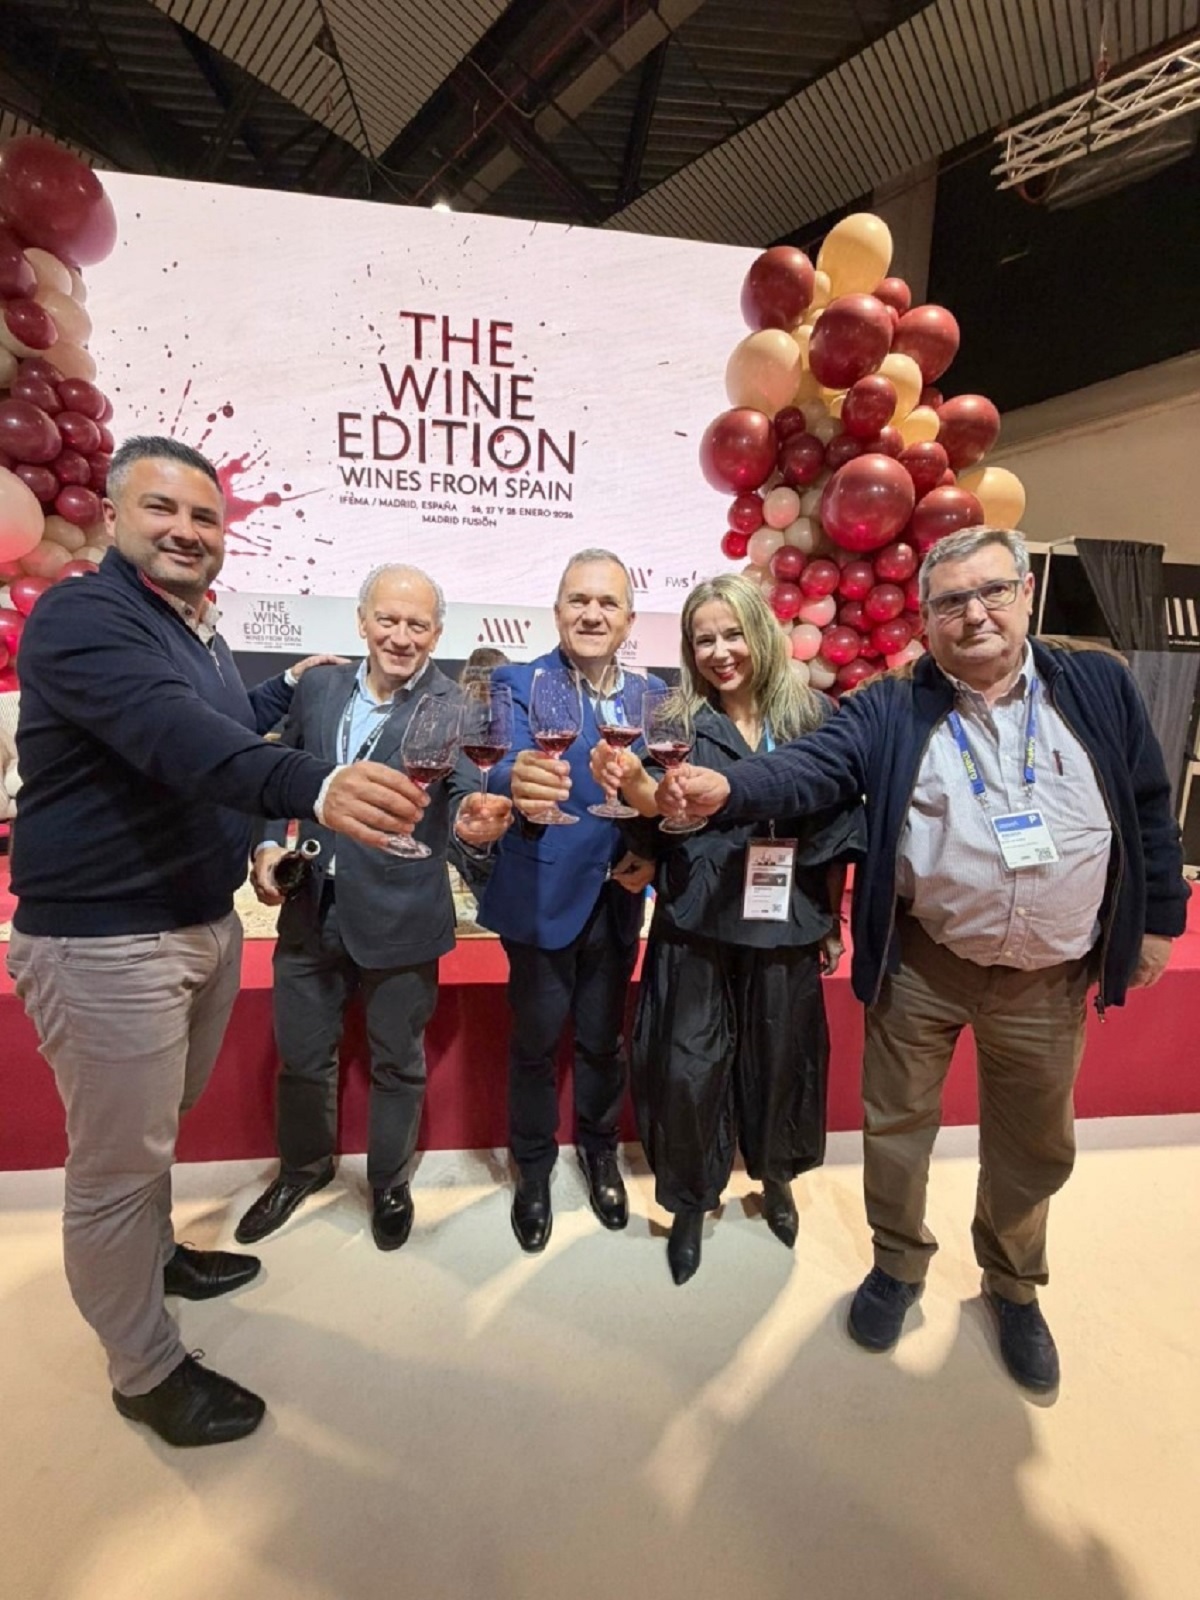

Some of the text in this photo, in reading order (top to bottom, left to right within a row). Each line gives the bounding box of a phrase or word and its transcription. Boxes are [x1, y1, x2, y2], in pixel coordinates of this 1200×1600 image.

[399, 310, 515, 369] THE
[379, 363, 535, 422] WINE
[337, 411, 576, 475] EDITION
[339, 465, 572, 502] WINES FROM SPAIN
[421, 500, 458, 511] ESPAÑA
[519, 507, 551, 517] ENERO
[422, 515, 459, 525] MADRID
[665, 576, 689, 588] FWS
[258, 600, 286, 613] THE
[253, 611, 291, 625] WINE
[243, 623, 302, 636] EDITION
[962, 750, 978, 780] makro
